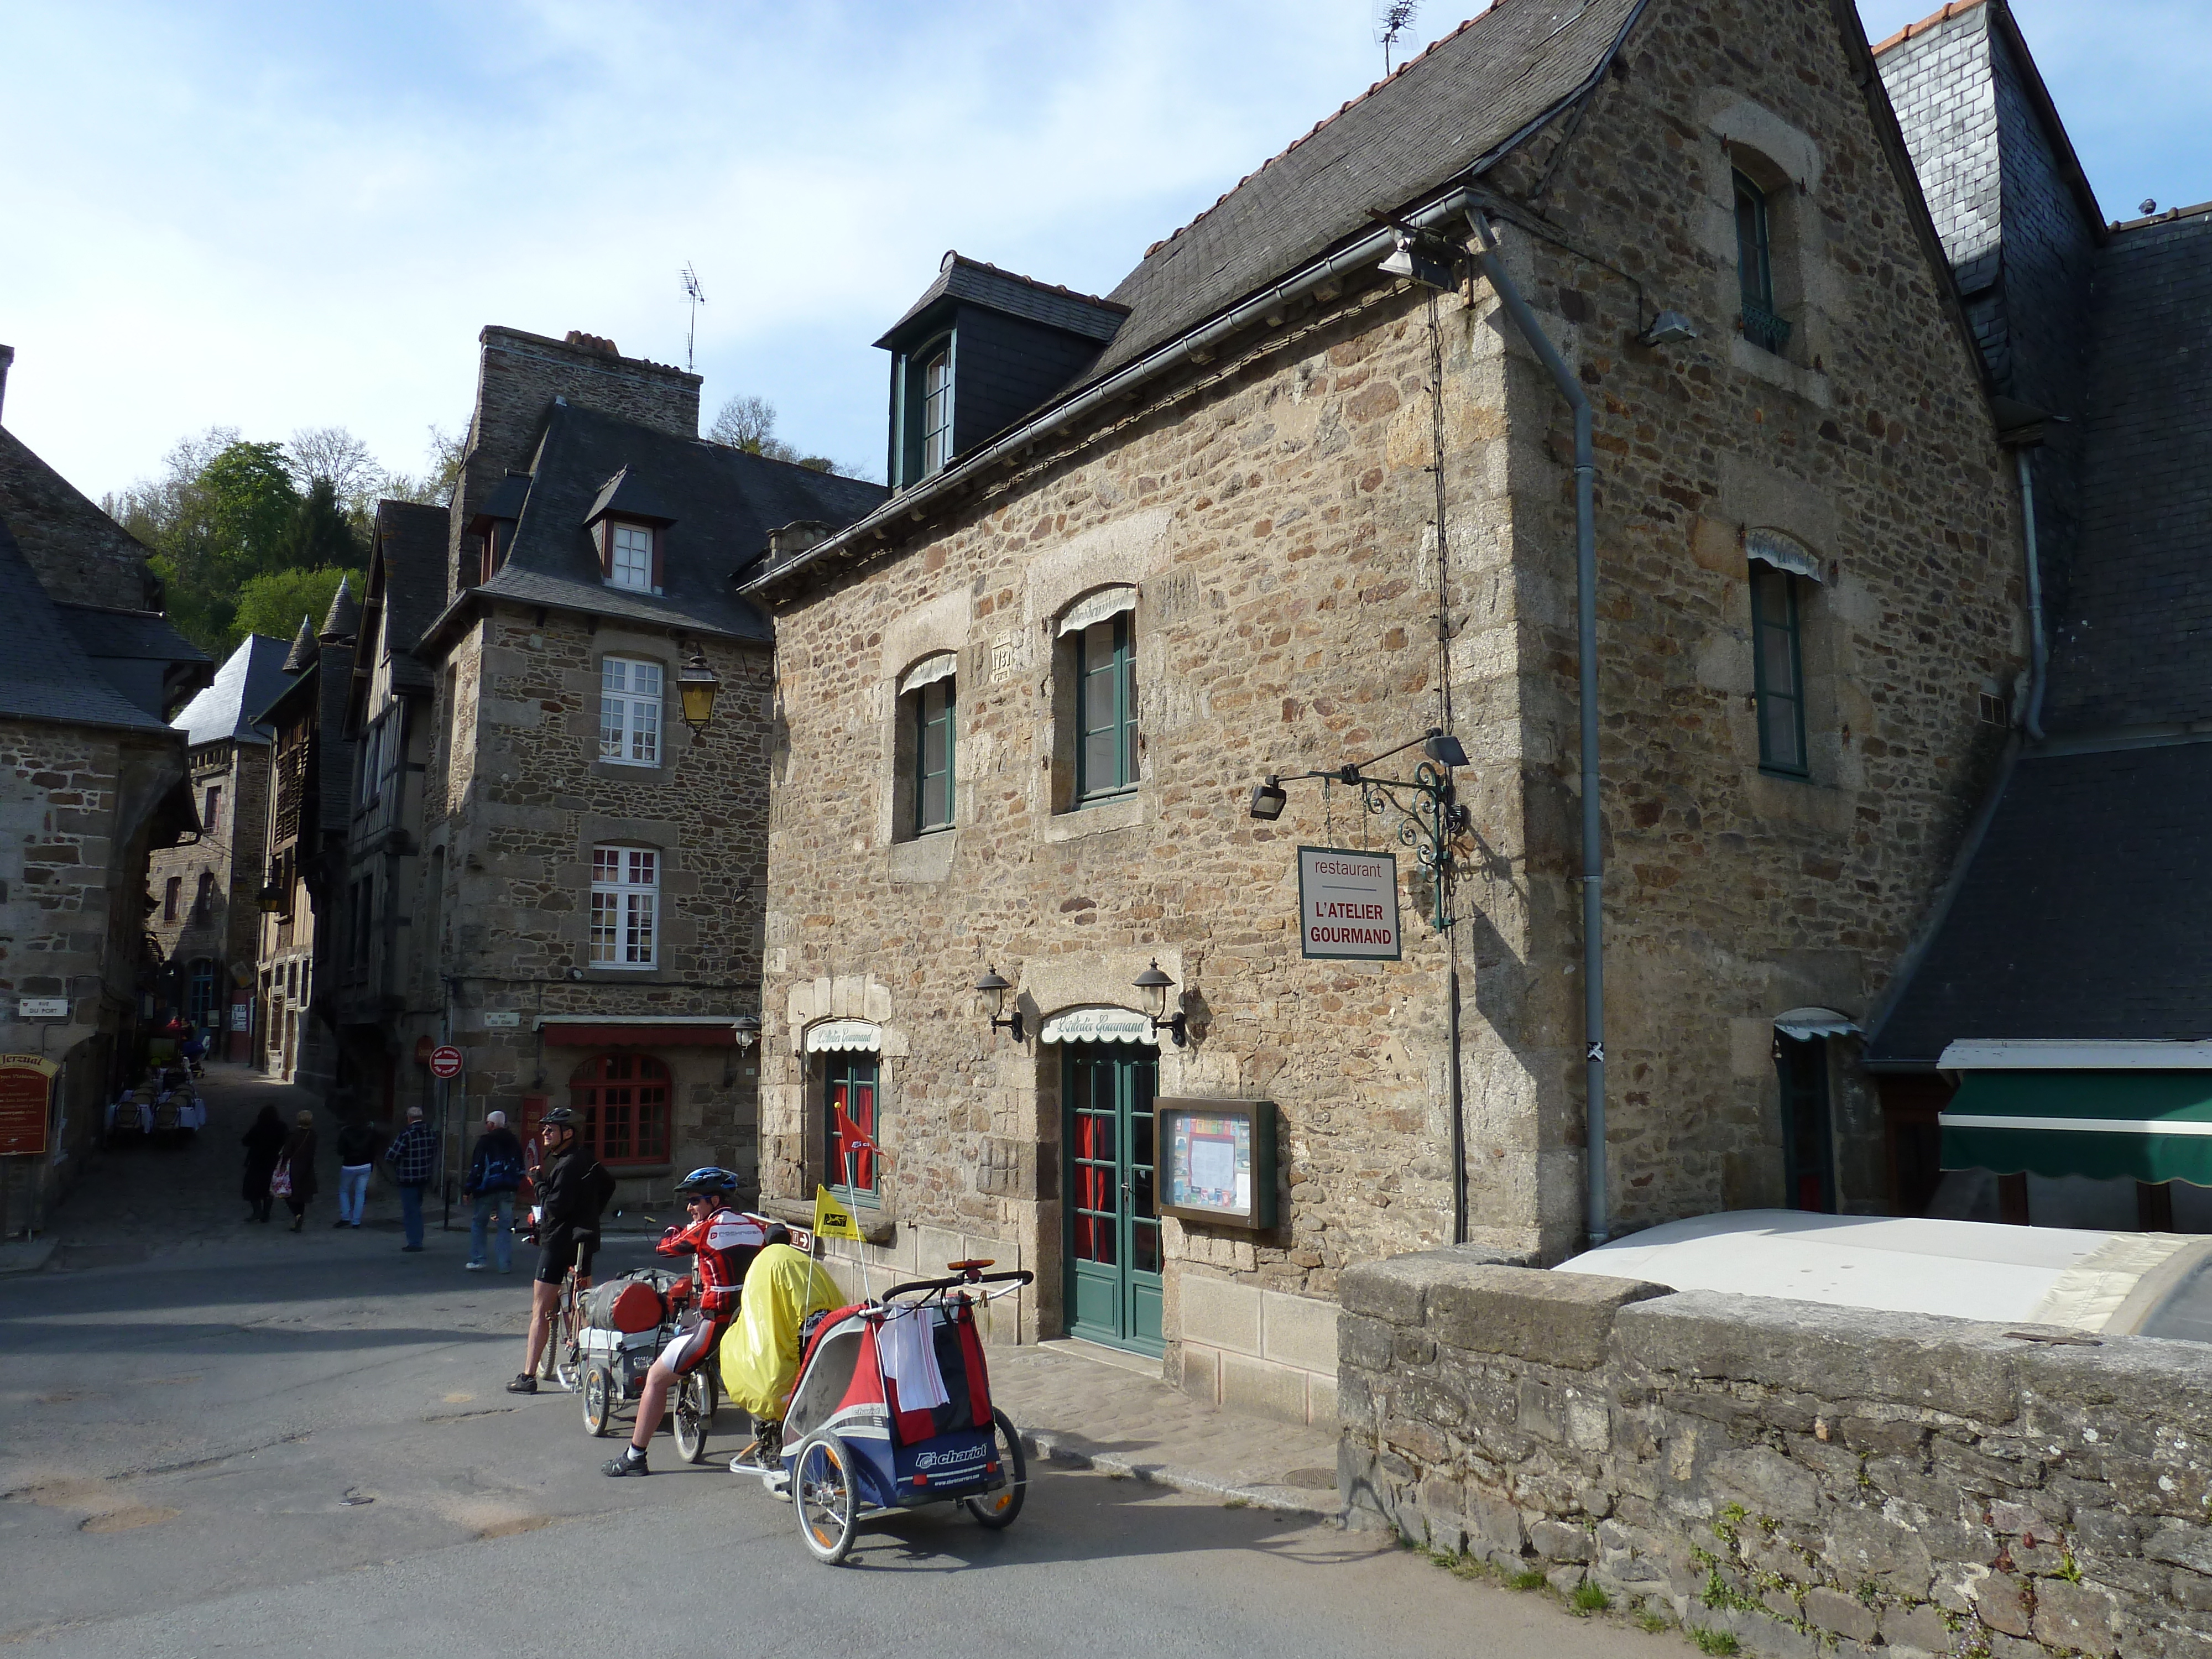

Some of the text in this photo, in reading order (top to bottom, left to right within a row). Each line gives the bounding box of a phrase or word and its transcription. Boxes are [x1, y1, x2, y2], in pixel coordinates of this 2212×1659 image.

[1315, 860, 1382, 878] restaurant
[1316, 902, 1383, 920] L'ATELIER
[1311, 926, 1391, 945] GOURMAND
[1095, 1015, 1148, 1035] Gourmand
[841, 1027, 873, 1046] Gourmand
[938, 1444, 987, 1465] chariot
